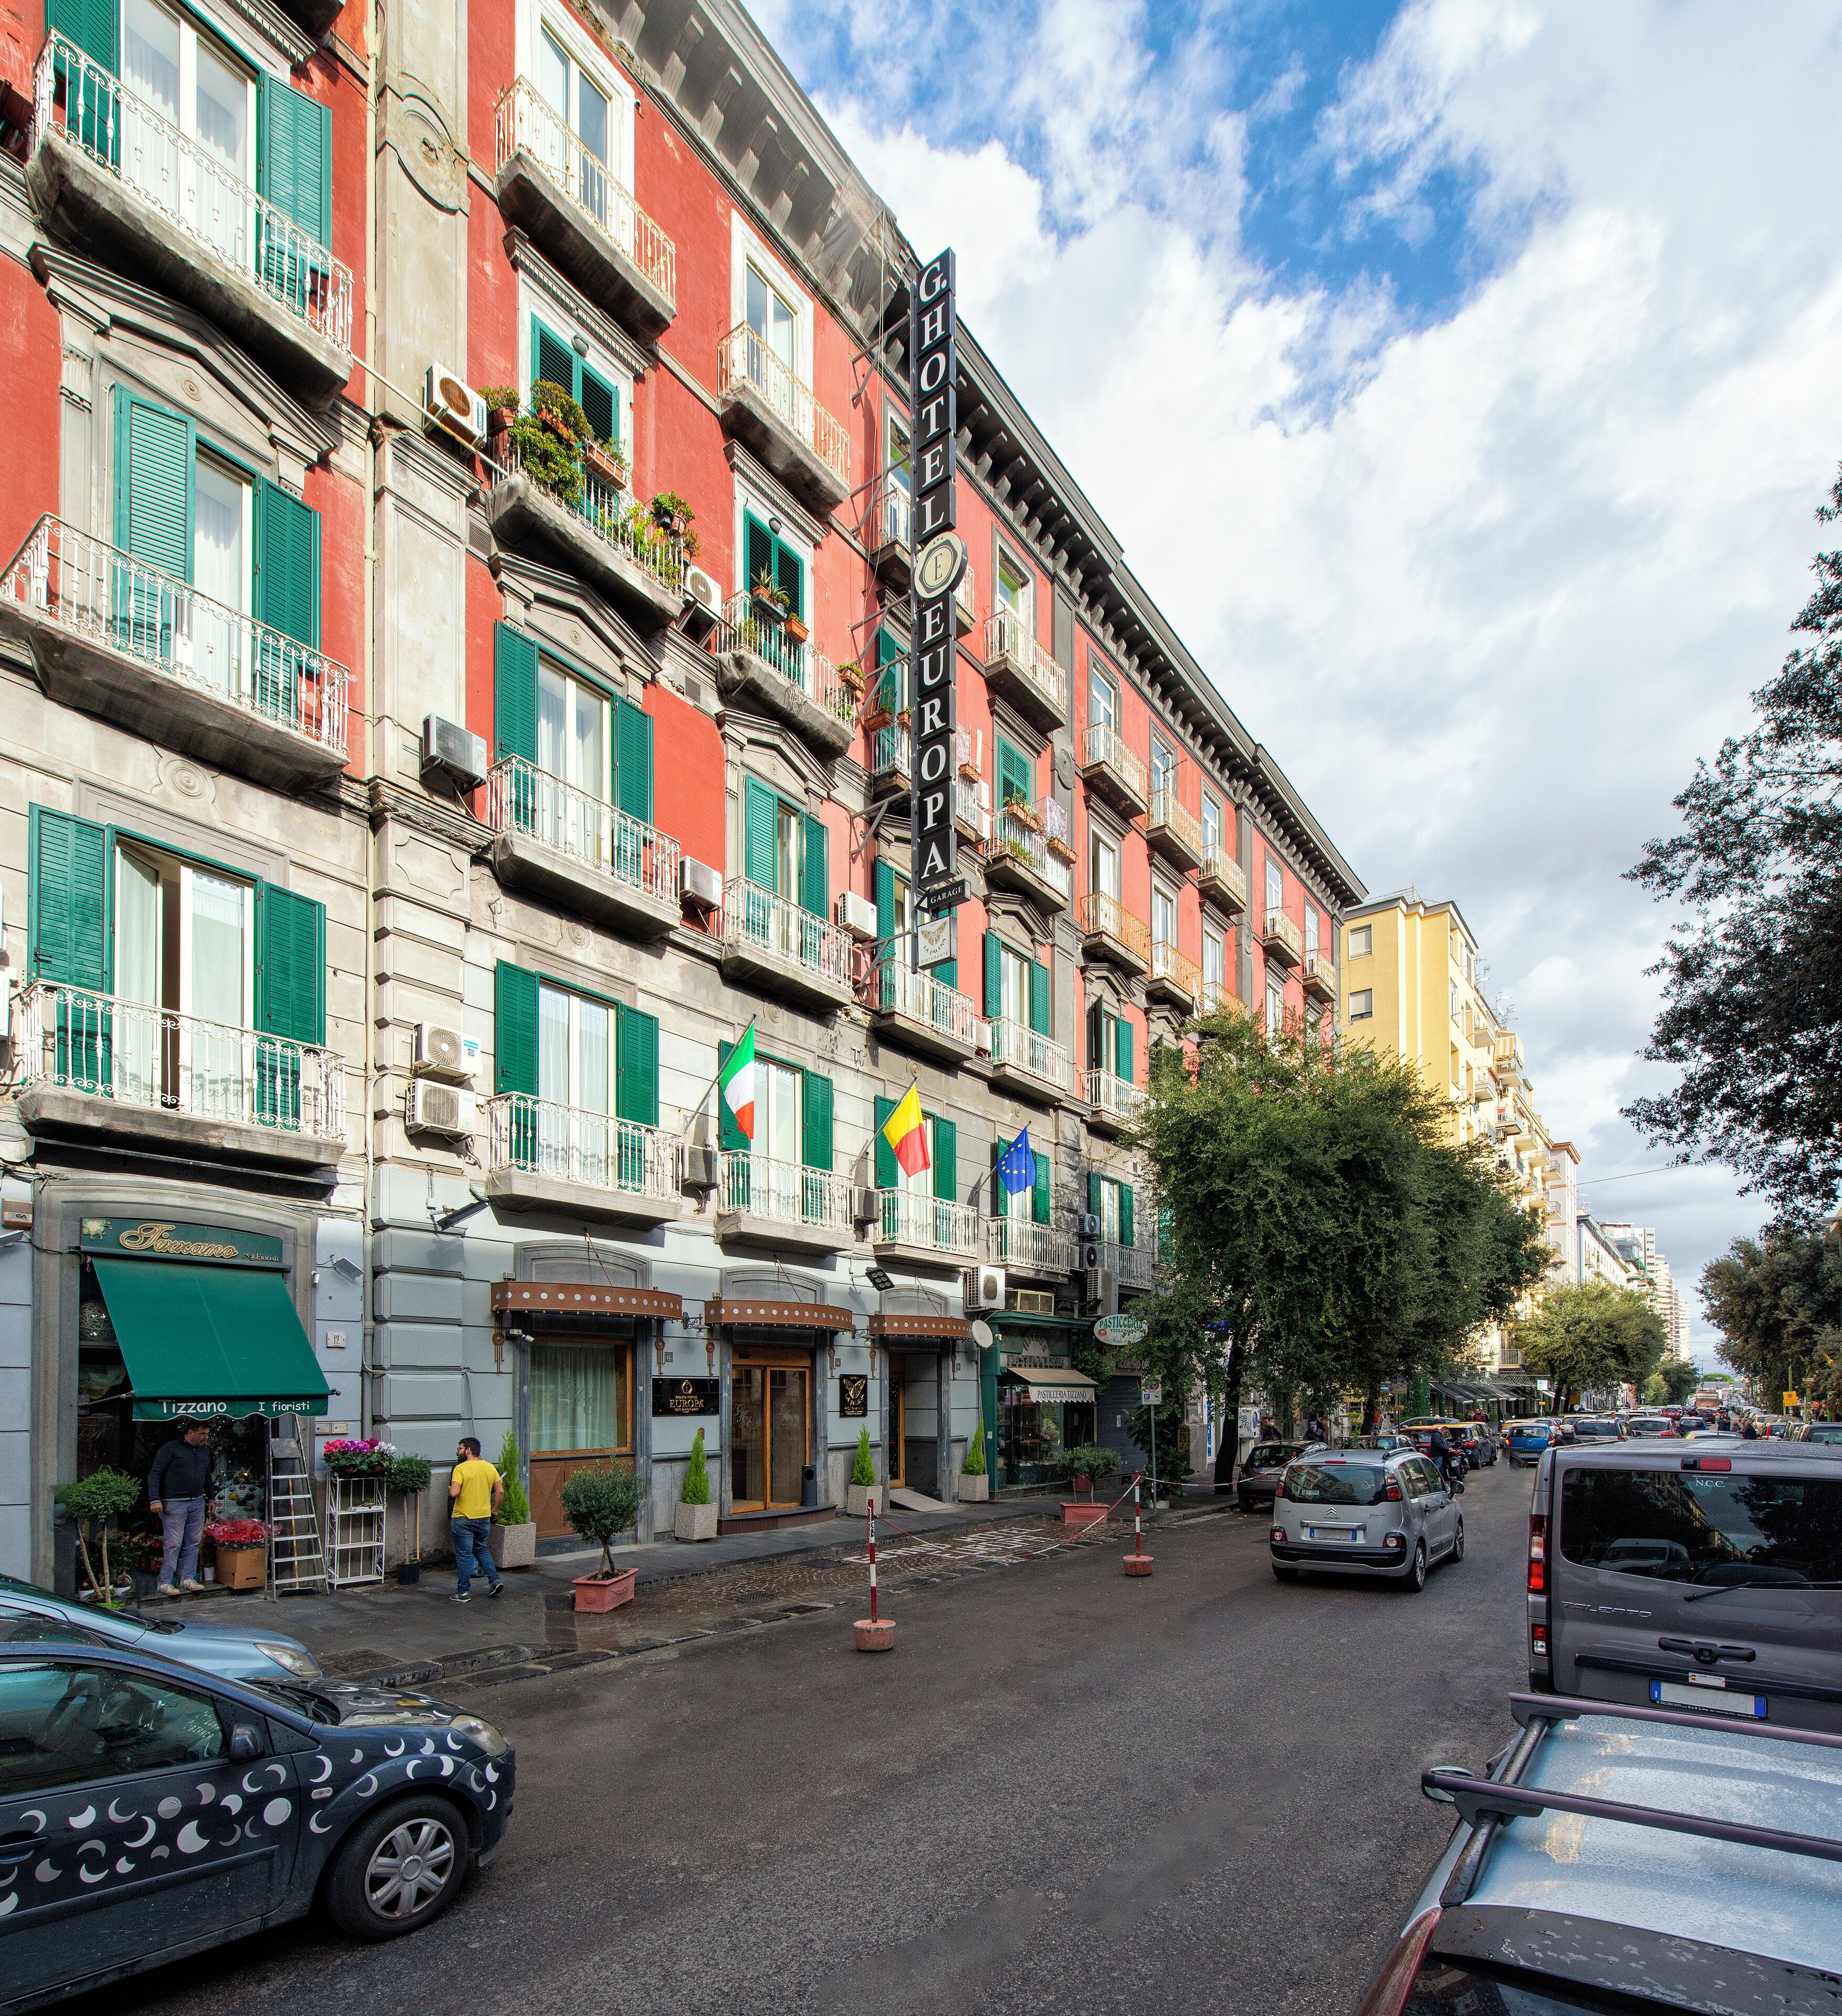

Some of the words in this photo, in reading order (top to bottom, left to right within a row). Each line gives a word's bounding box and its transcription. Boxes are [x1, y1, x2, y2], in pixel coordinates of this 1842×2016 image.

[921, 301, 946, 534] HOTEL
[920, 602, 947, 879] EUROPA
[930, 886, 963, 904] GARAGE
[929, 938, 946, 955] FALENA
[921, 951, 948, 964] RISTORANTE
[119, 1223, 238, 1258] Tizzano
[1099, 1316, 1144, 1329] PASTICCERIA
[333, 1335, 340, 1345] 12
[1120, 1359, 1140, 1369] CORO
[1037, 1390, 1066, 1399] PASTICCERIA
[1067, 1390, 1086, 1399] TIZZANO
[158, 1400, 226, 1413] Tizzano
[271, 1401, 309, 1411] fioristi
[669, 1399, 704, 1408] EUROPA
[841, 1543, 951, 1564] GRAND
[952, 1527, 1045, 1543] HOTEL
[926, 1535, 1055, 1559] EUROPA
[1562, 1601, 1652, 1618] TALENTO
